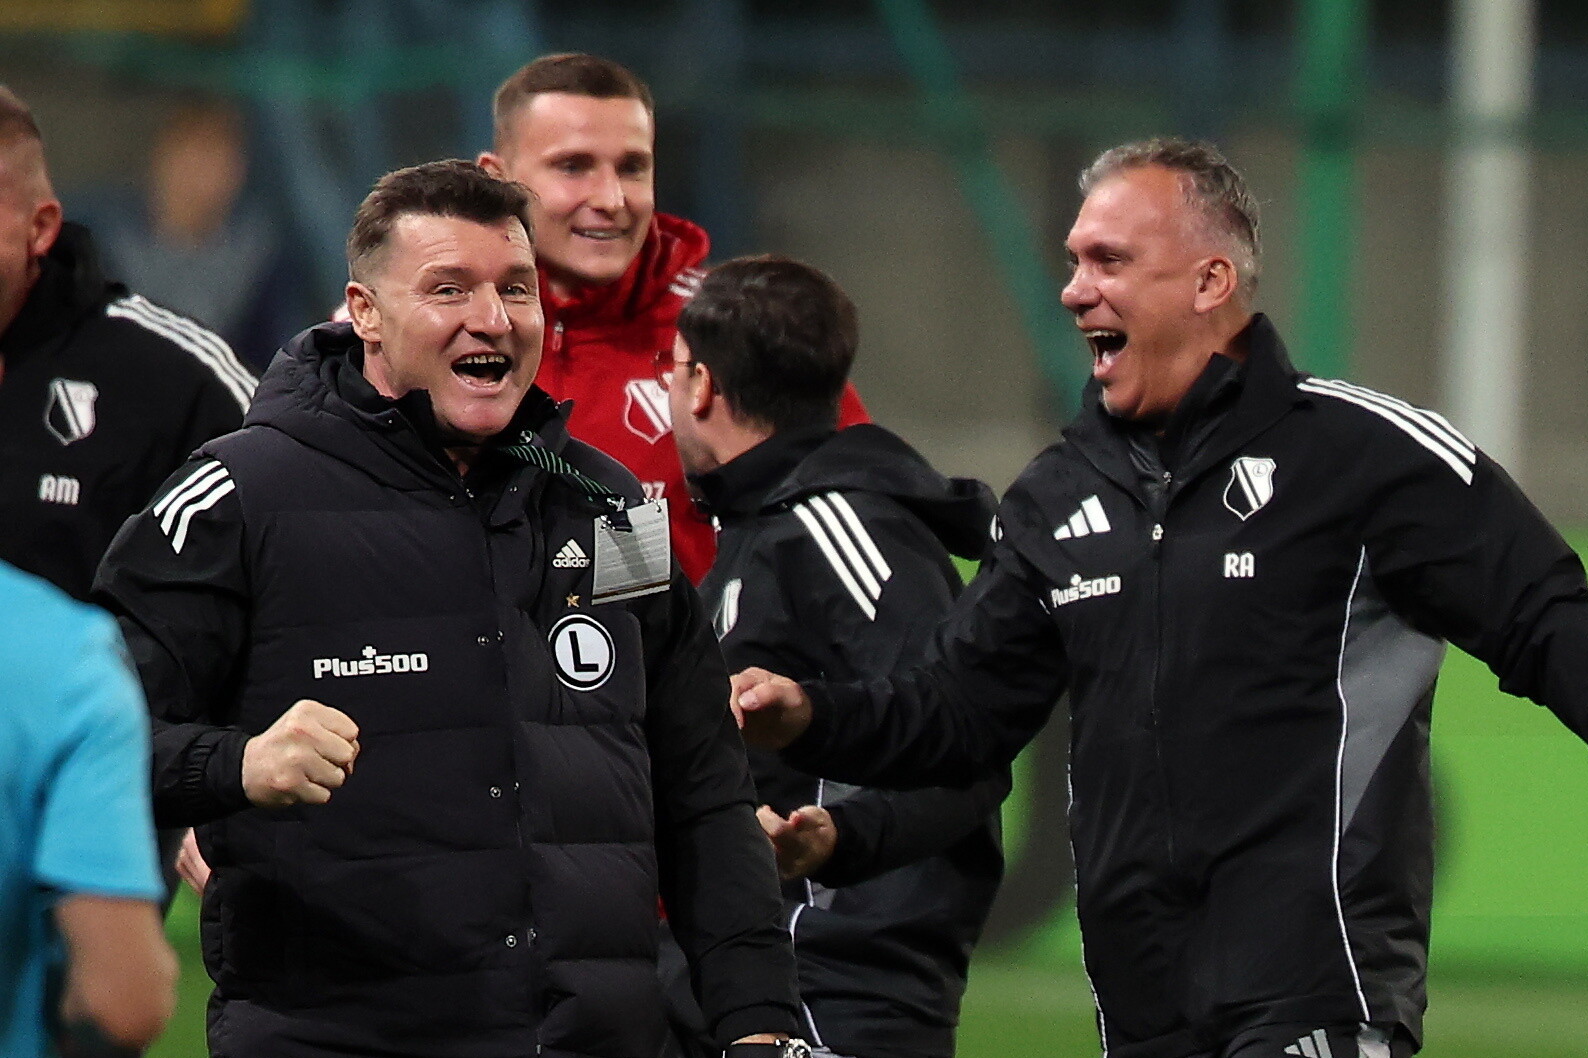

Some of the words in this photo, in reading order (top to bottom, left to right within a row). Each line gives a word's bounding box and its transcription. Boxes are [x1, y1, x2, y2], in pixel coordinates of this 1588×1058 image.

[39, 473, 80, 505] AM
[552, 556, 591, 568] adidas
[1224, 552, 1255, 578] RA
[313, 646, 428, 679] Plus500
[568, 630, 599, 673] L
